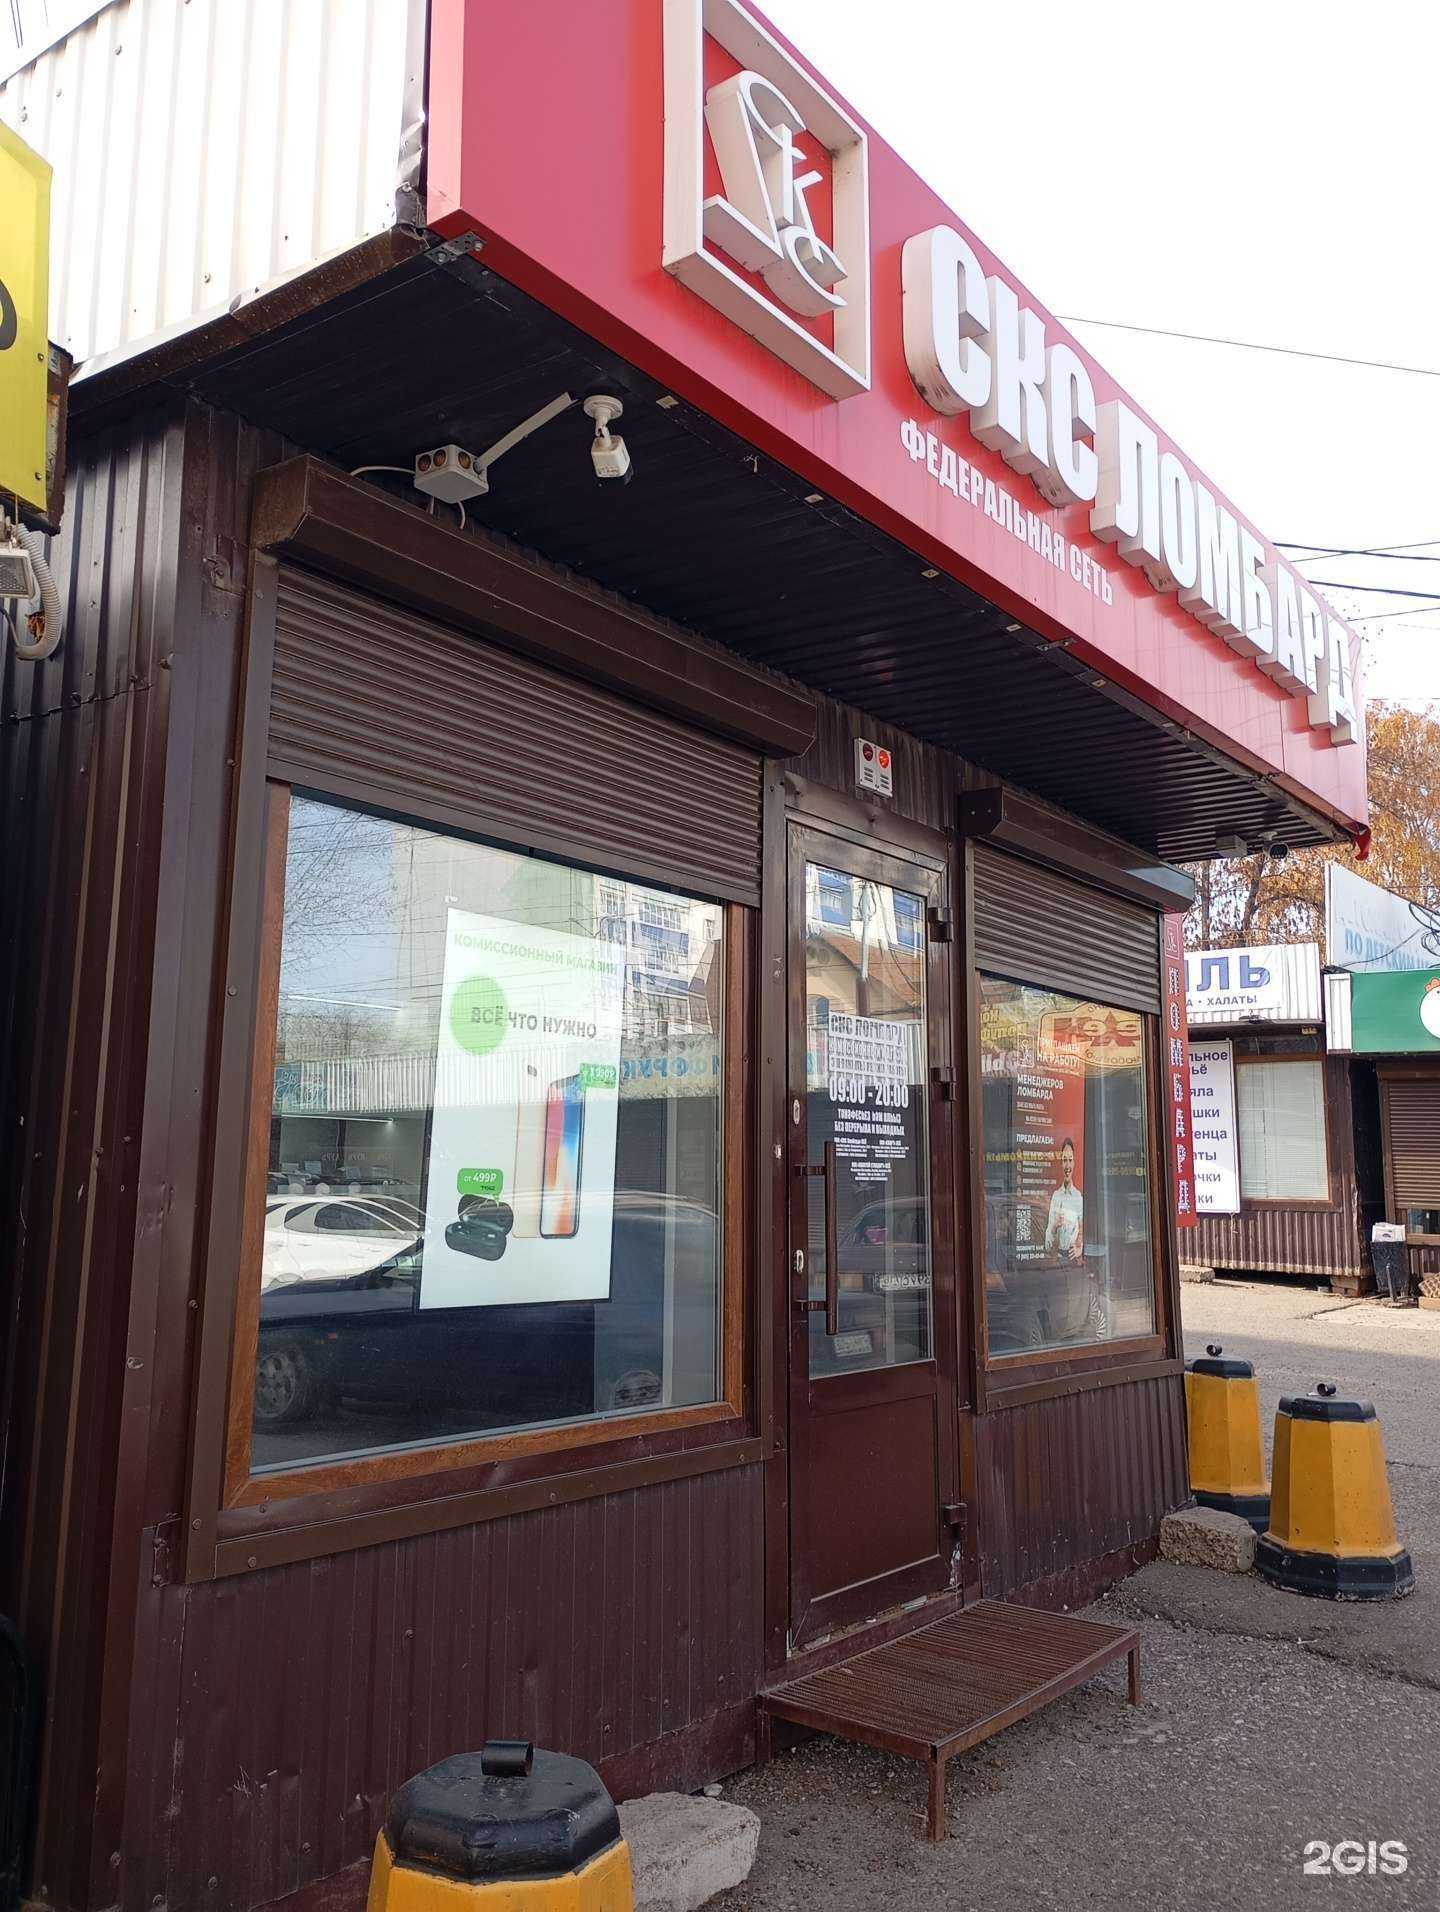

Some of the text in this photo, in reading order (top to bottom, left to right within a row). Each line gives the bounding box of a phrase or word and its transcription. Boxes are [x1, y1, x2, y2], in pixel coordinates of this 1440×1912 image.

[903, 224, 1359, 744] СКС ЛОМБАРД
[900, 419, 1114, 606] ФЕДЕРАЛЬНАЯ СЕТЬ
[454, 933, 618, 974] КОМИССИОННЫЙ МАГАЗИН
[1184, 955, 1270, 992] ЛЬ
[1207, 995, 1257, 1006] ХАЛАТЫ
[471, 1005, 597, 1039] ВСЁ ЧТО НУЖНО
[1188, 1051, 1228, 1062] льное
[1191, 1063, 1207, 1075] ьё
[1017, 1074, 1064, 1089] МЕНЕДЖЕРОВ
[829, 1074, 866, 1104] 09:00
[875, 1081, 909, 1109] 20:00
[1017, 1086, 1054, 1101] ЛОМБАРДА
[1189, 1087, 1214, 1097] яла
[1193, 1108, 1220, 1118] шки
[1193, 1129, 1227, 1141] енца
[1194, 1173, 1221, 1182] чки
[1197, 1194, 1213, 1204] ки
